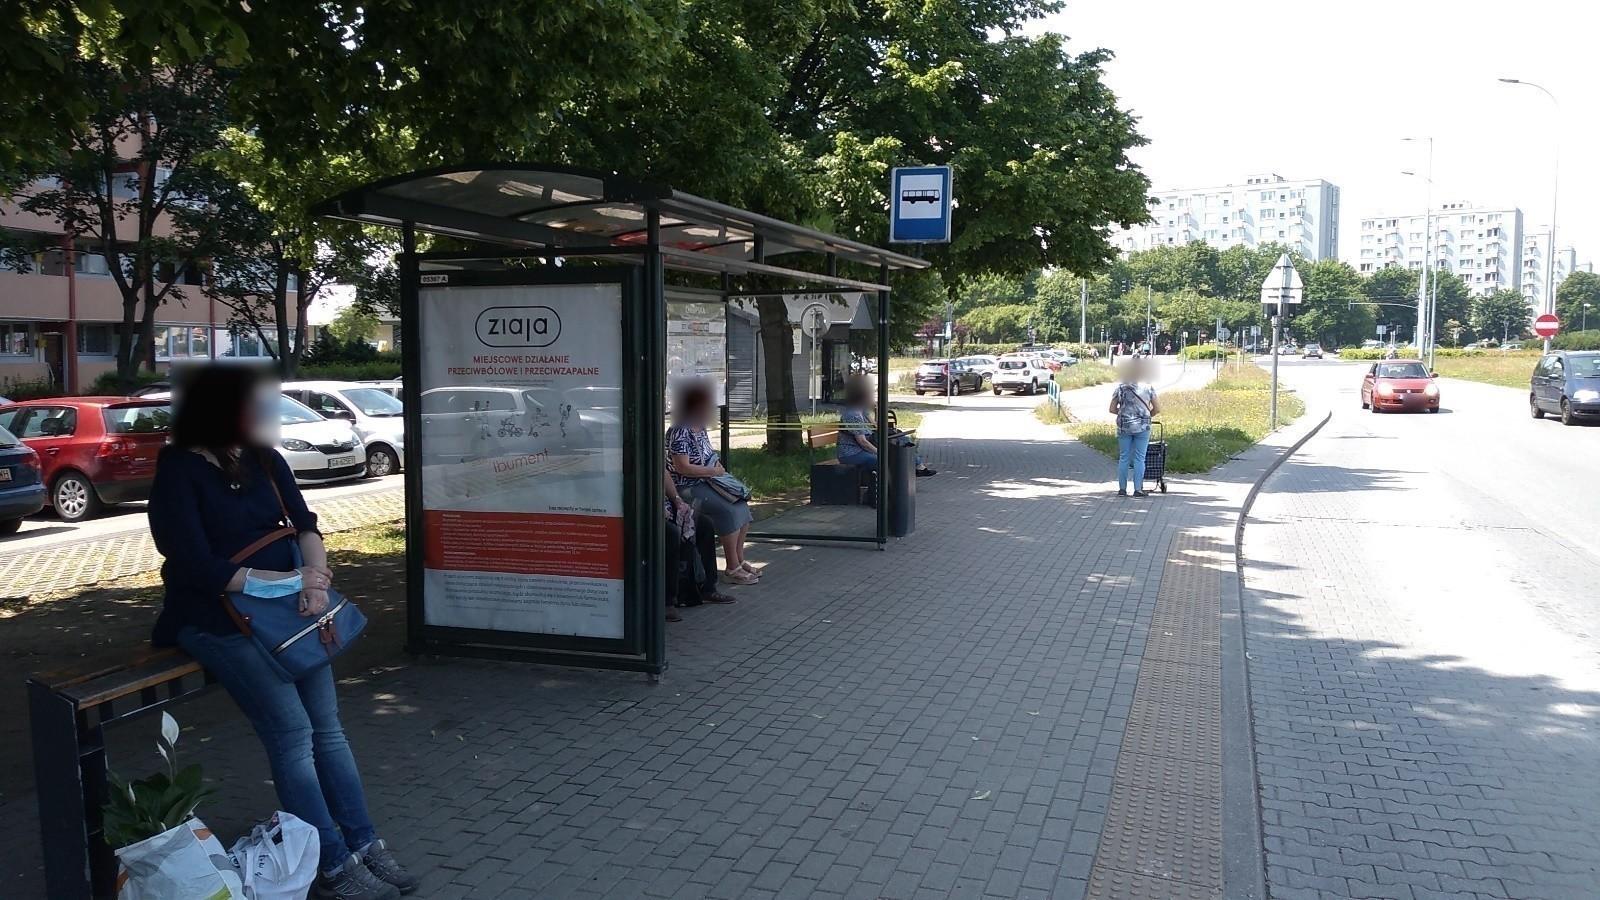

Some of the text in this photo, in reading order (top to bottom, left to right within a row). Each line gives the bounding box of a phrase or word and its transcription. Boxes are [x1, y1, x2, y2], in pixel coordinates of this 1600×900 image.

[488, 317, 548, 342] ziaja
[473, 355, 570, 364] MIEJSCOWE DZIAŁANIE
[448, 366, 518, 376] PRZECIWBÓLOWE
[525, 367, 599, 376] PRZECIWZAPALNE
